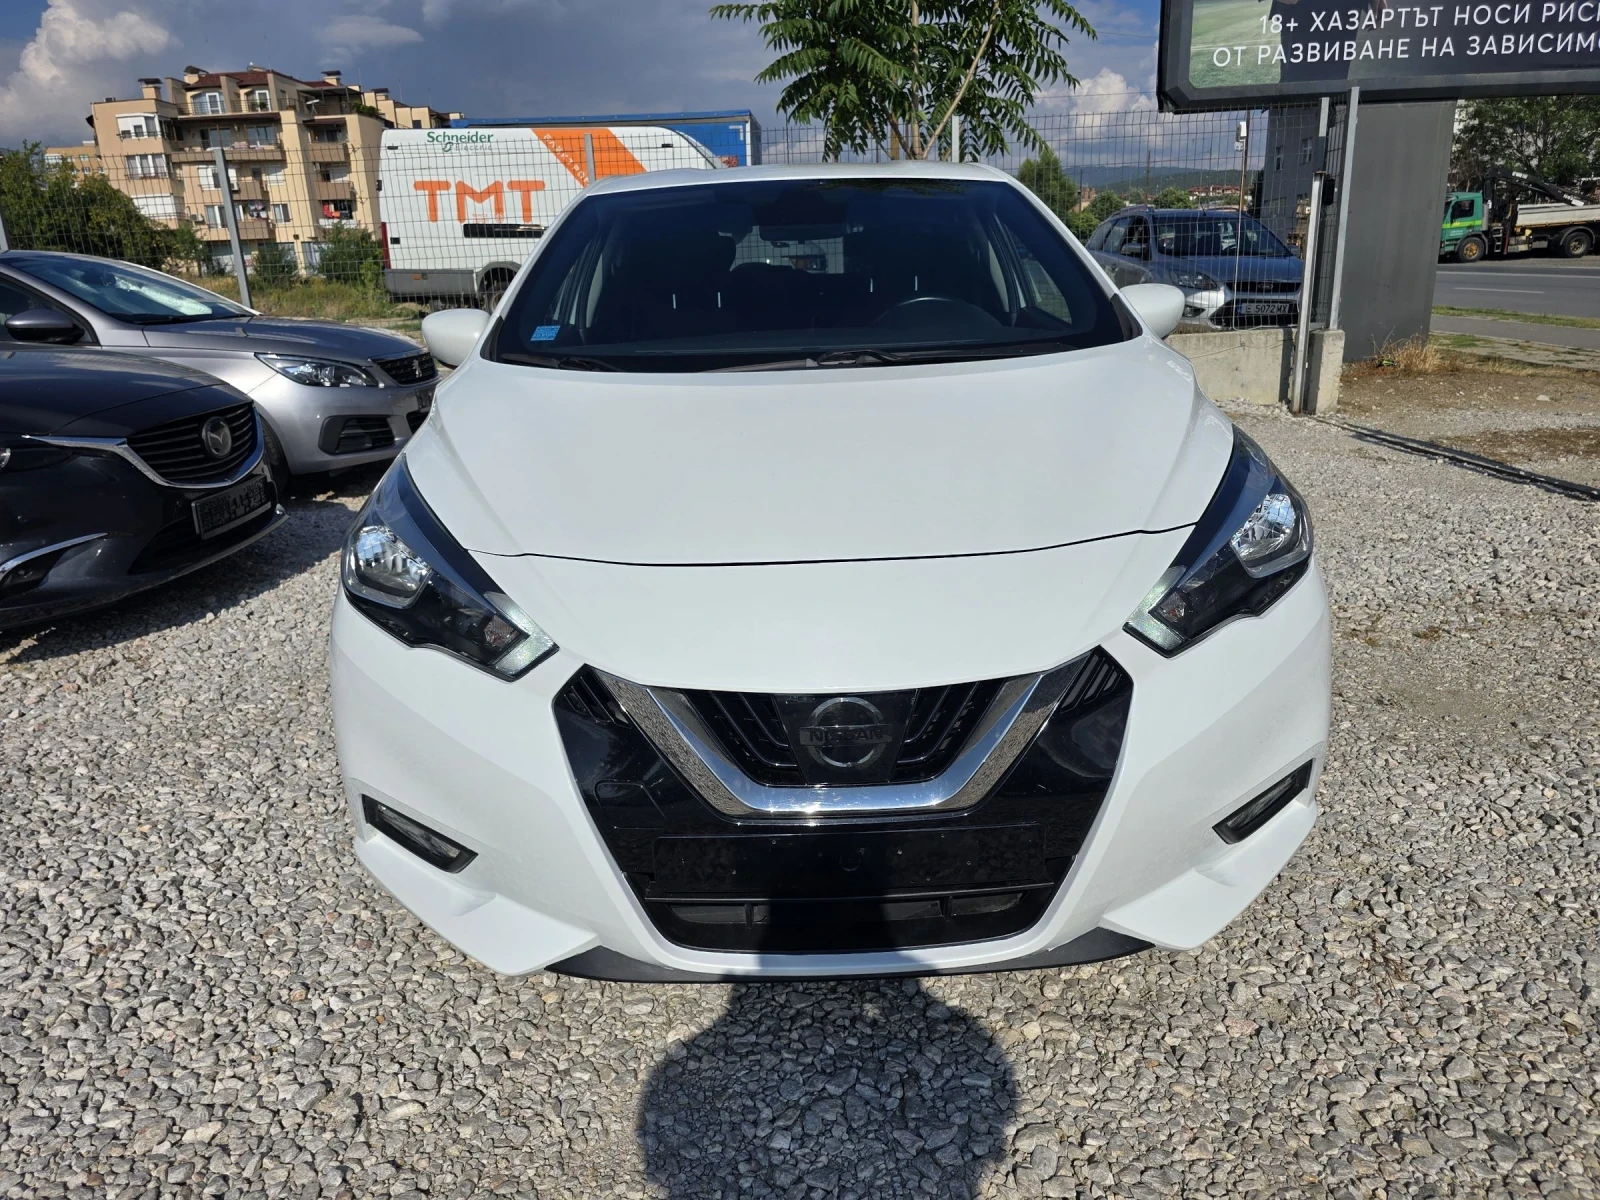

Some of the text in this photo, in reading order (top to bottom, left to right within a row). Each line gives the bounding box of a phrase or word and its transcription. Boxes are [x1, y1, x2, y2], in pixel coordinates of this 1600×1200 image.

[1259, 14, 1299, 35] 18+
[1309, 7, 1443, 33] ХАЗАРТЪТ
[1454, 4, 1531, 26] НОСИ
[1213, 46, 1247, 67] ОТ
[1257, 38, 1410, 65] РАЗВИВАНЕ
[1421, 37, 1455, 57] НА
[426, 131, 494, 143] Schneider
[413, 180, 546, 223] TMT
[1255, 304, 1276, 313] 5072
[809, 727, 884, 742] NISSAN
